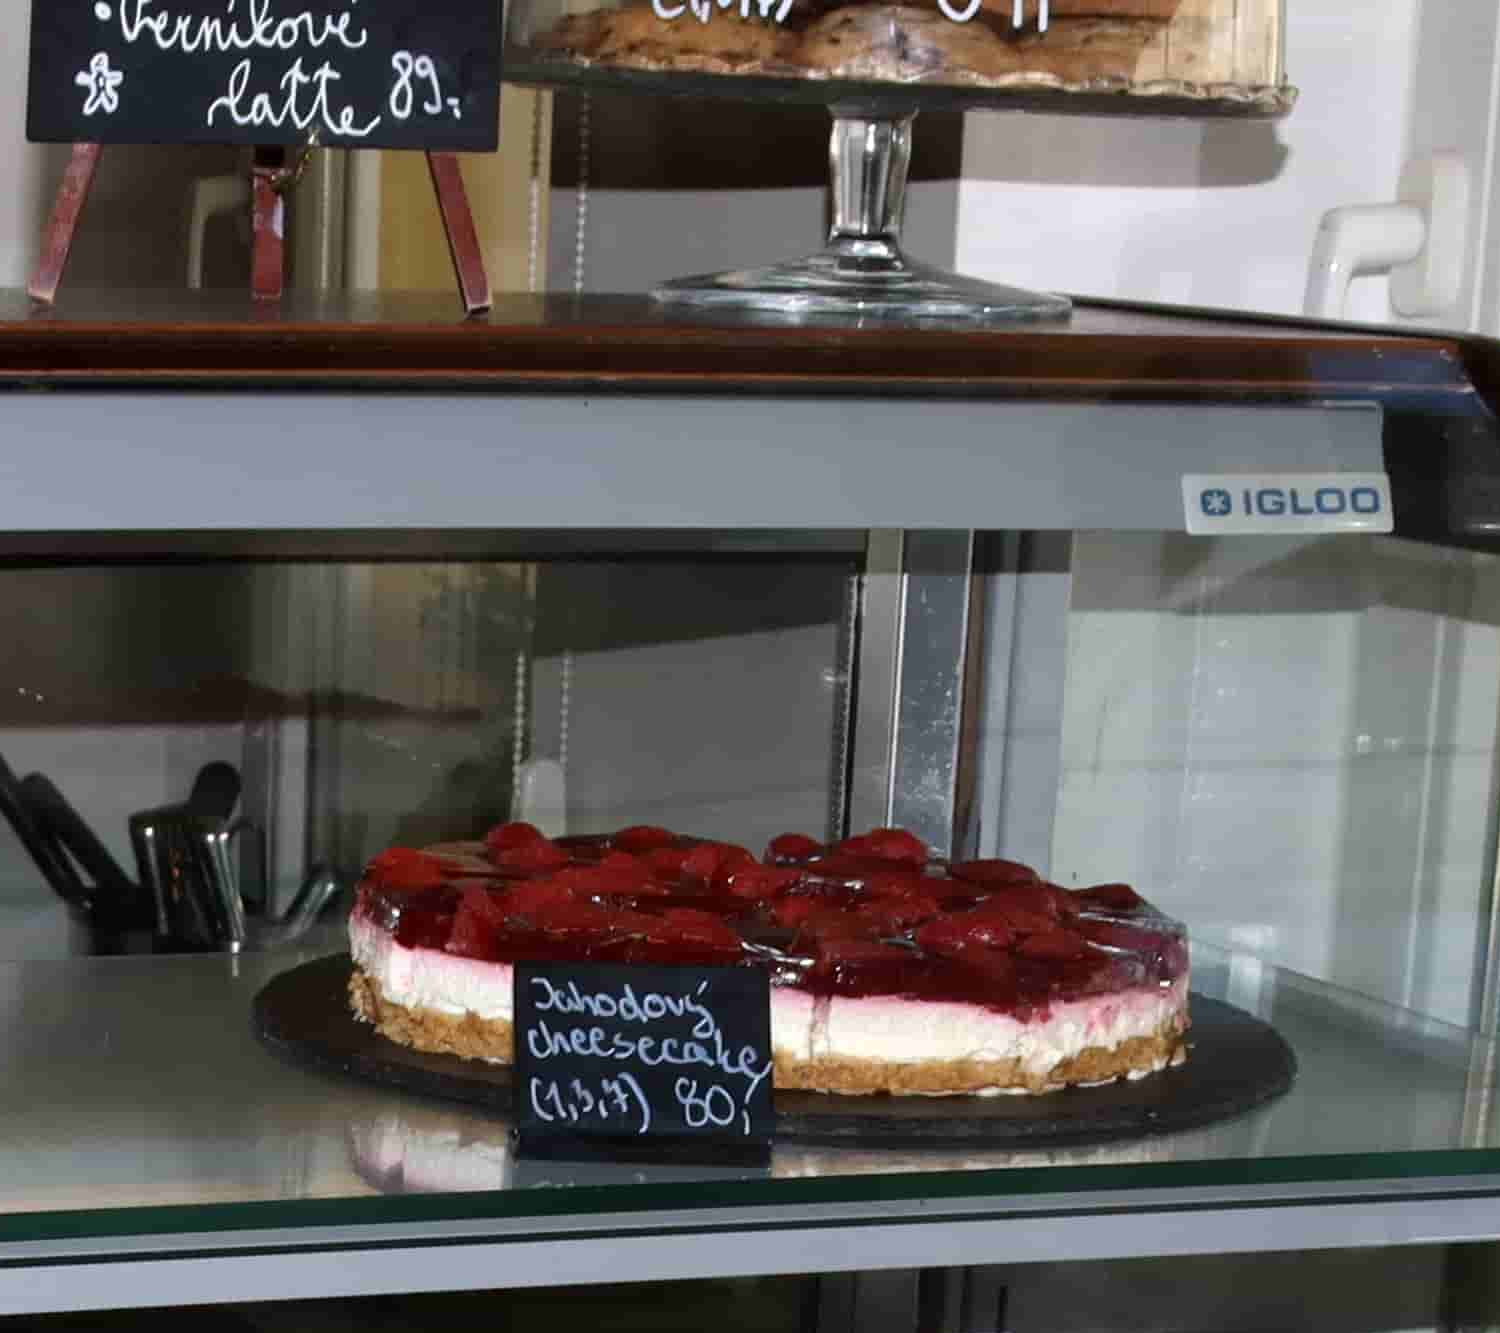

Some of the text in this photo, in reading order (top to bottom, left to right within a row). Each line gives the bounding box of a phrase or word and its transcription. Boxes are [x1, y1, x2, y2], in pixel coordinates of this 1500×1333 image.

[207, 58, 381, 136] latte
[1243, 487, 1381, 516] IGLOO
[531, 977, 715, 1038] Jahodový
[528, 1020, 773, 1078] cheesecake
